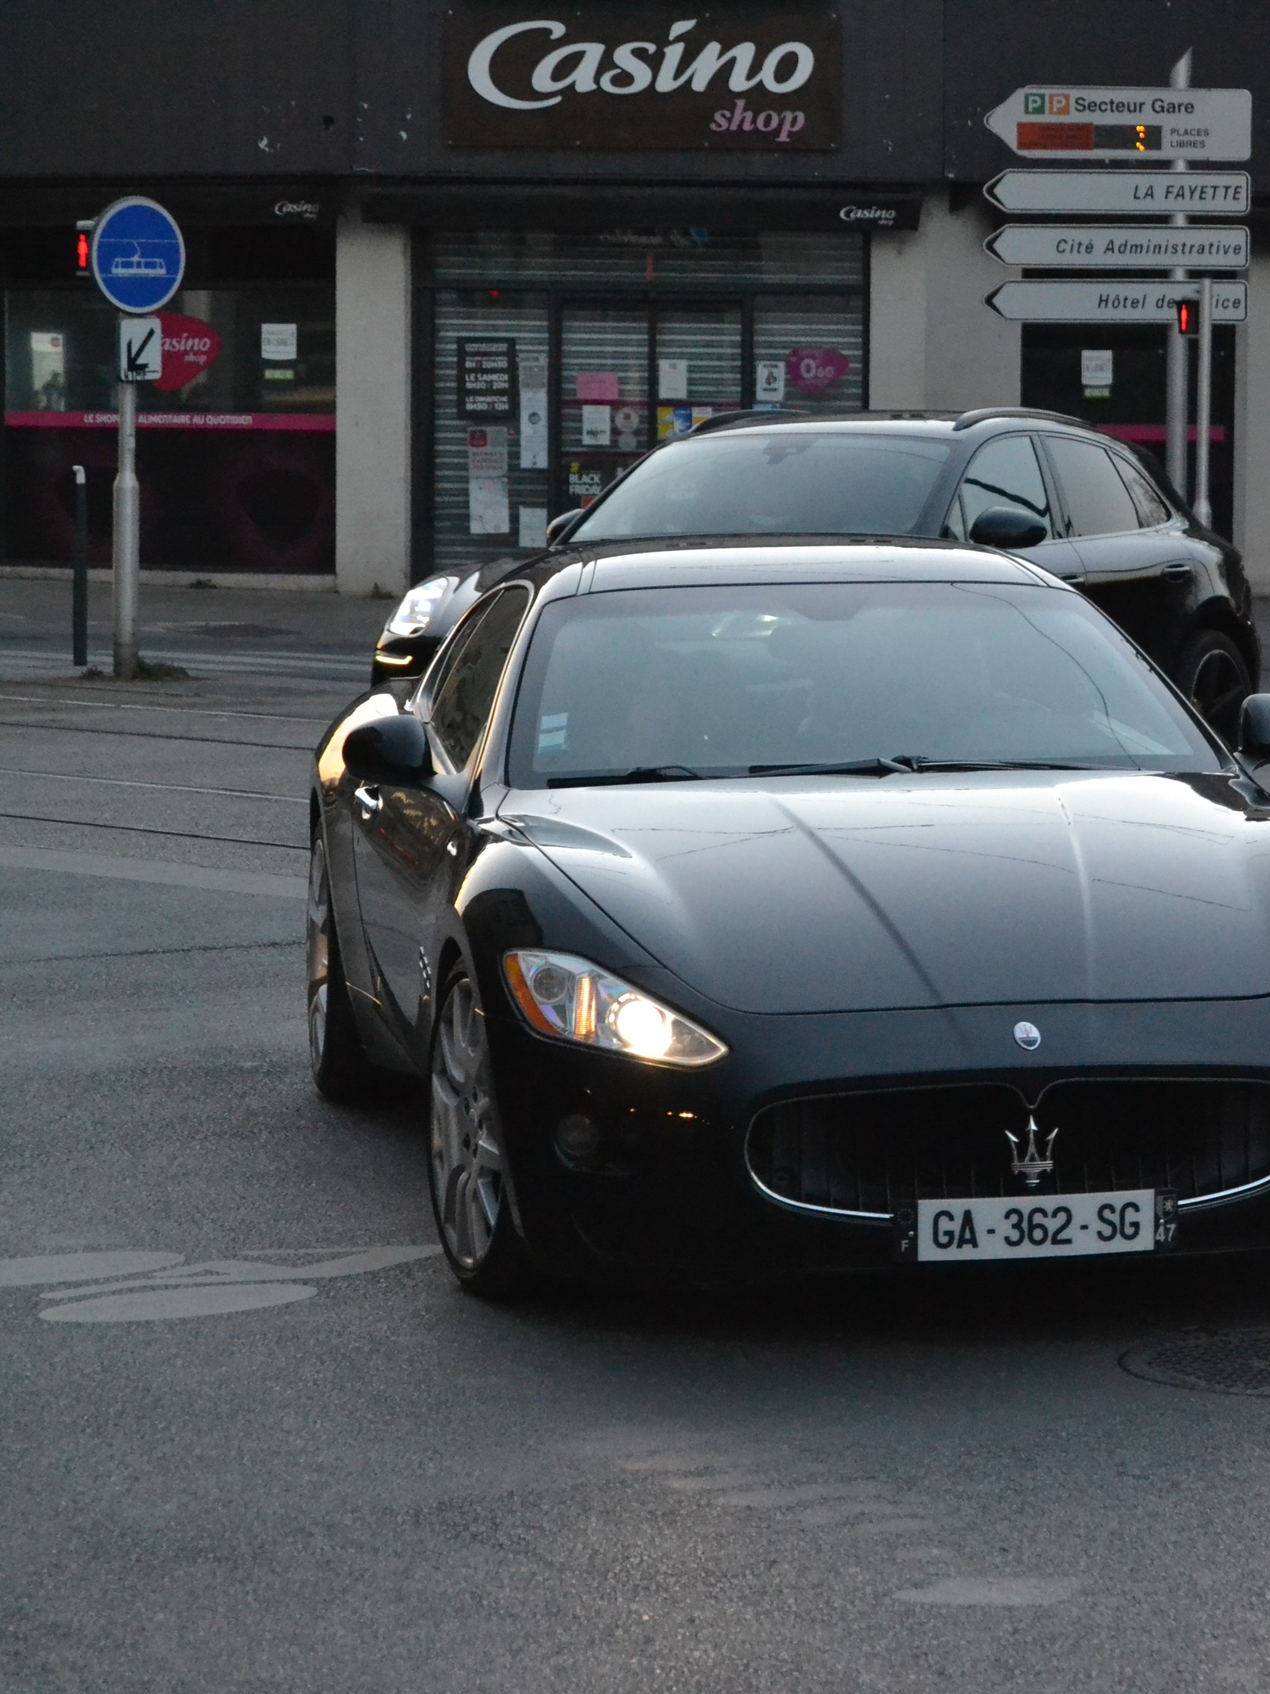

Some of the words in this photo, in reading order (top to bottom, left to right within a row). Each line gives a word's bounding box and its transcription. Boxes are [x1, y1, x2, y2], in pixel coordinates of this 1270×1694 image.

[467, 18, 815, 110] Casino
[1074, 97, 1146, 114] Secteur
[1151, 98, 1195, 114] Gare
[709, 99, 806, 142] shop
[1170, 128, 1210, 137] PLACES
[1170, 140, 1206, 149] LIBRES
[1133, 184, 1154, 201] LA
[1164, 184, 1242, 201] FAYETTE
[839, 205, 897, 222] Casino
[1056, 238, 1094, 255] Cité
[1104, 238, 1242, 255] Administrative
[1097, 293, 1147, 310] Hôtel
[1156, 294, 1175, 310] de
[1214, 294, 1241, 310] ice
[161, 332, 211, 352] asino
[569, 473, 601, 484] BLACK
[932, 1202, 1140, 1250] GA-362-SG
[1155, 1223, 1177, 1243] 47
[900, 1240, 910, 1252] F
